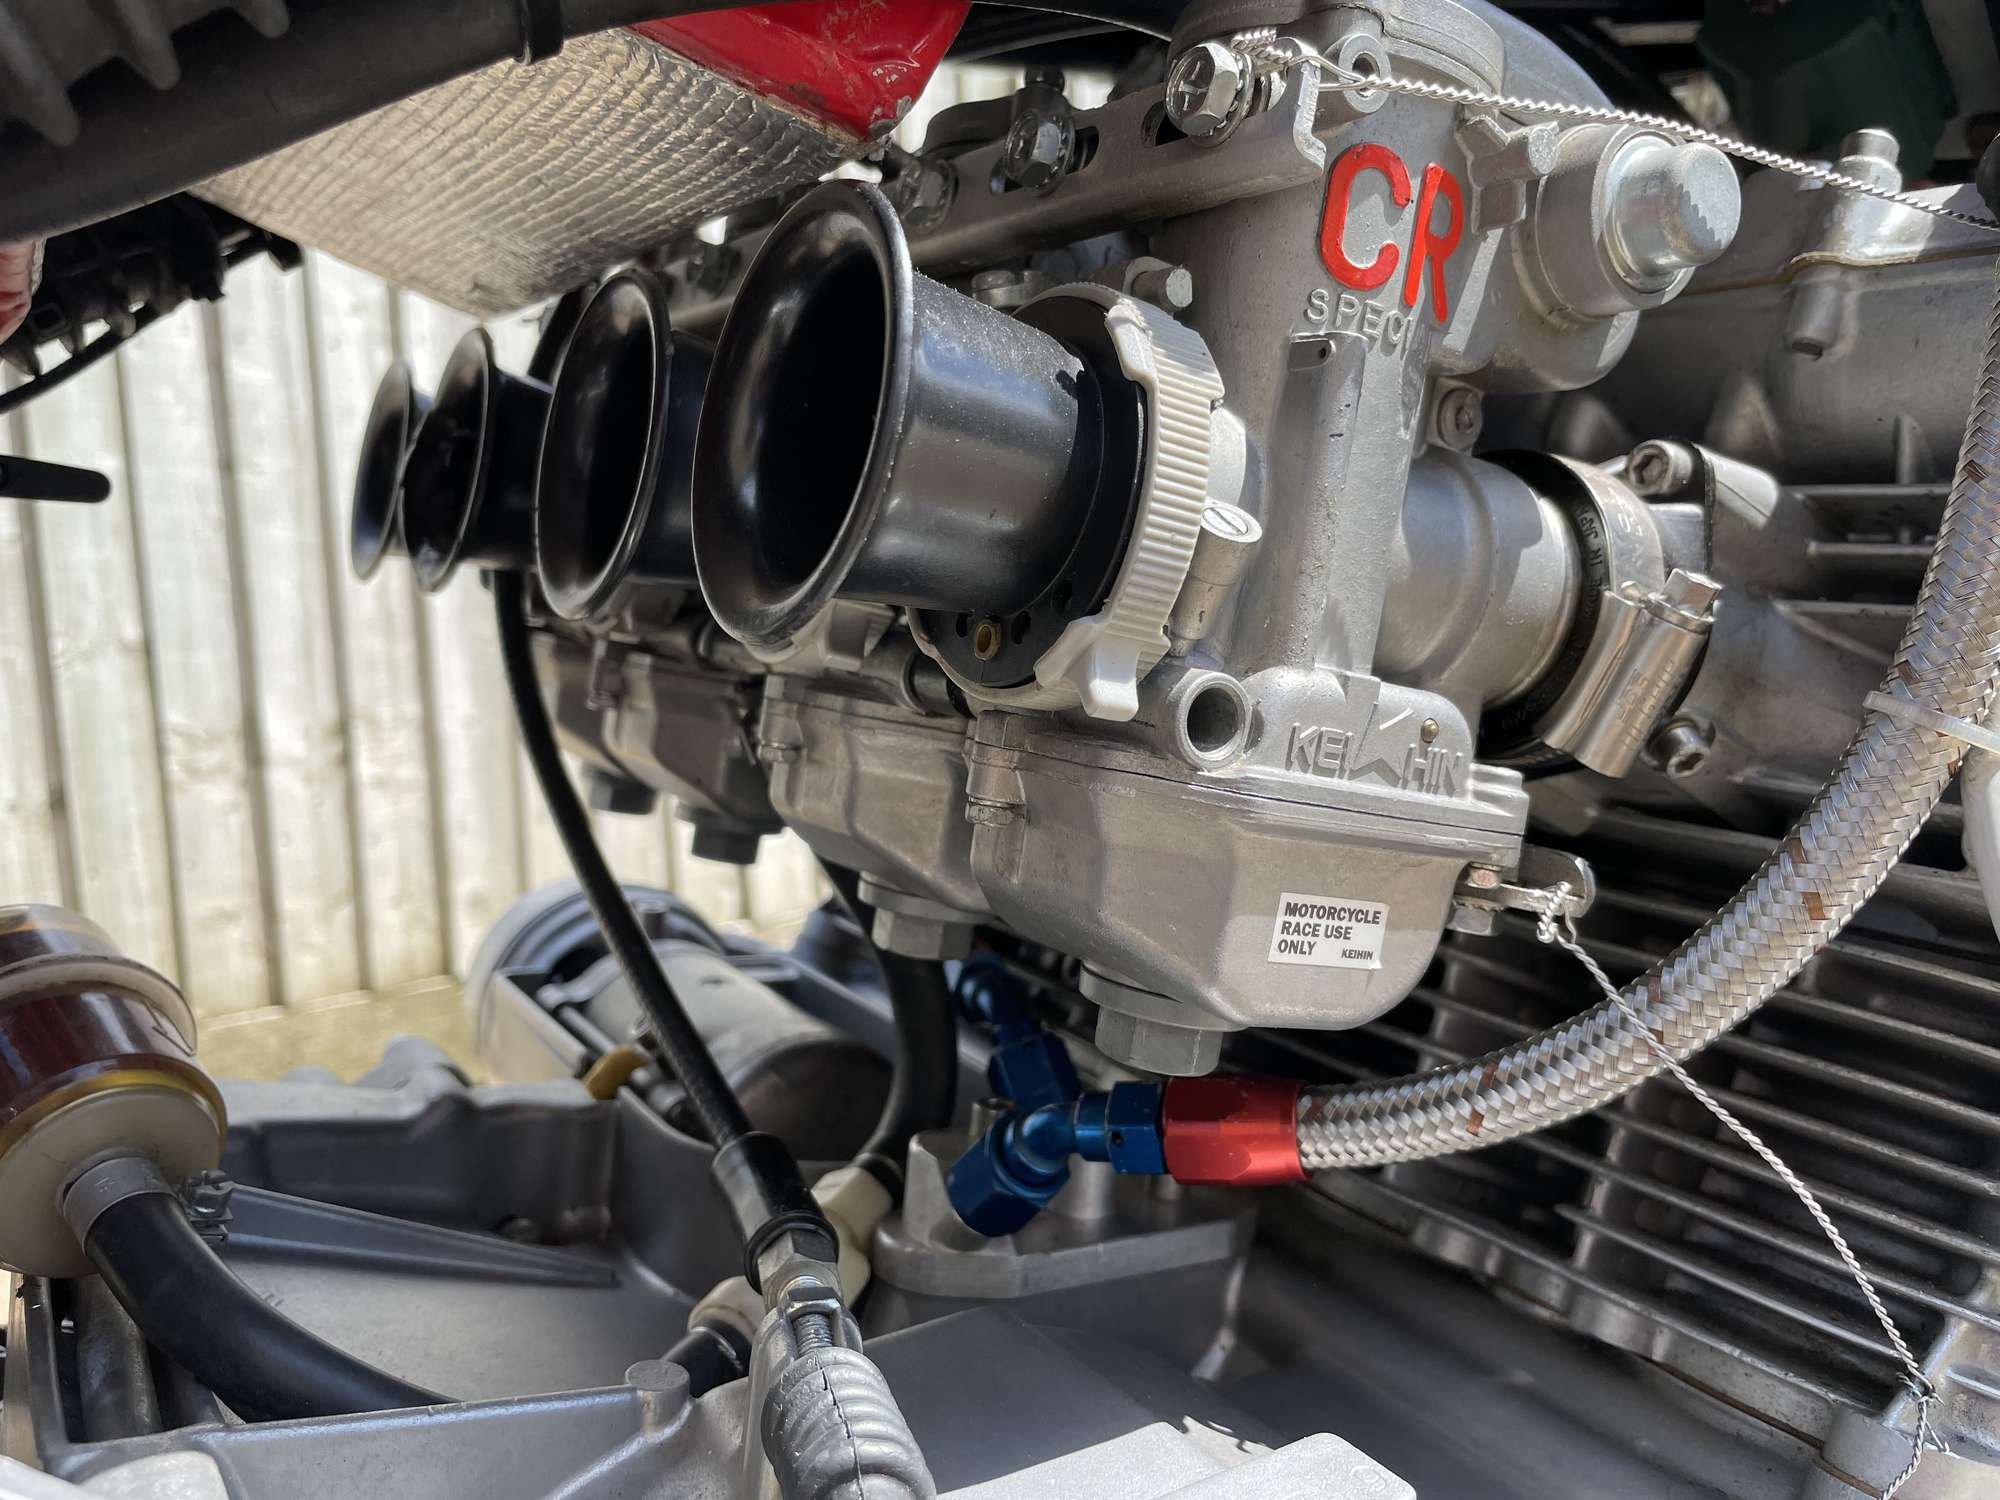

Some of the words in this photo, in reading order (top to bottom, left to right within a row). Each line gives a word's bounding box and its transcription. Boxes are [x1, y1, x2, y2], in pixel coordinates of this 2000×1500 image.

[1320, 142, 1466, 324] CR
[1284, 902, 1382, 925] MOTORCYCLE
[1281, 920, 1321, 938] RACE
[1324, 924, 1353, 941] USE
[1277, 939, 1317, 956] ONLY
[1341, 948, 1374, 961] KEIHIN
